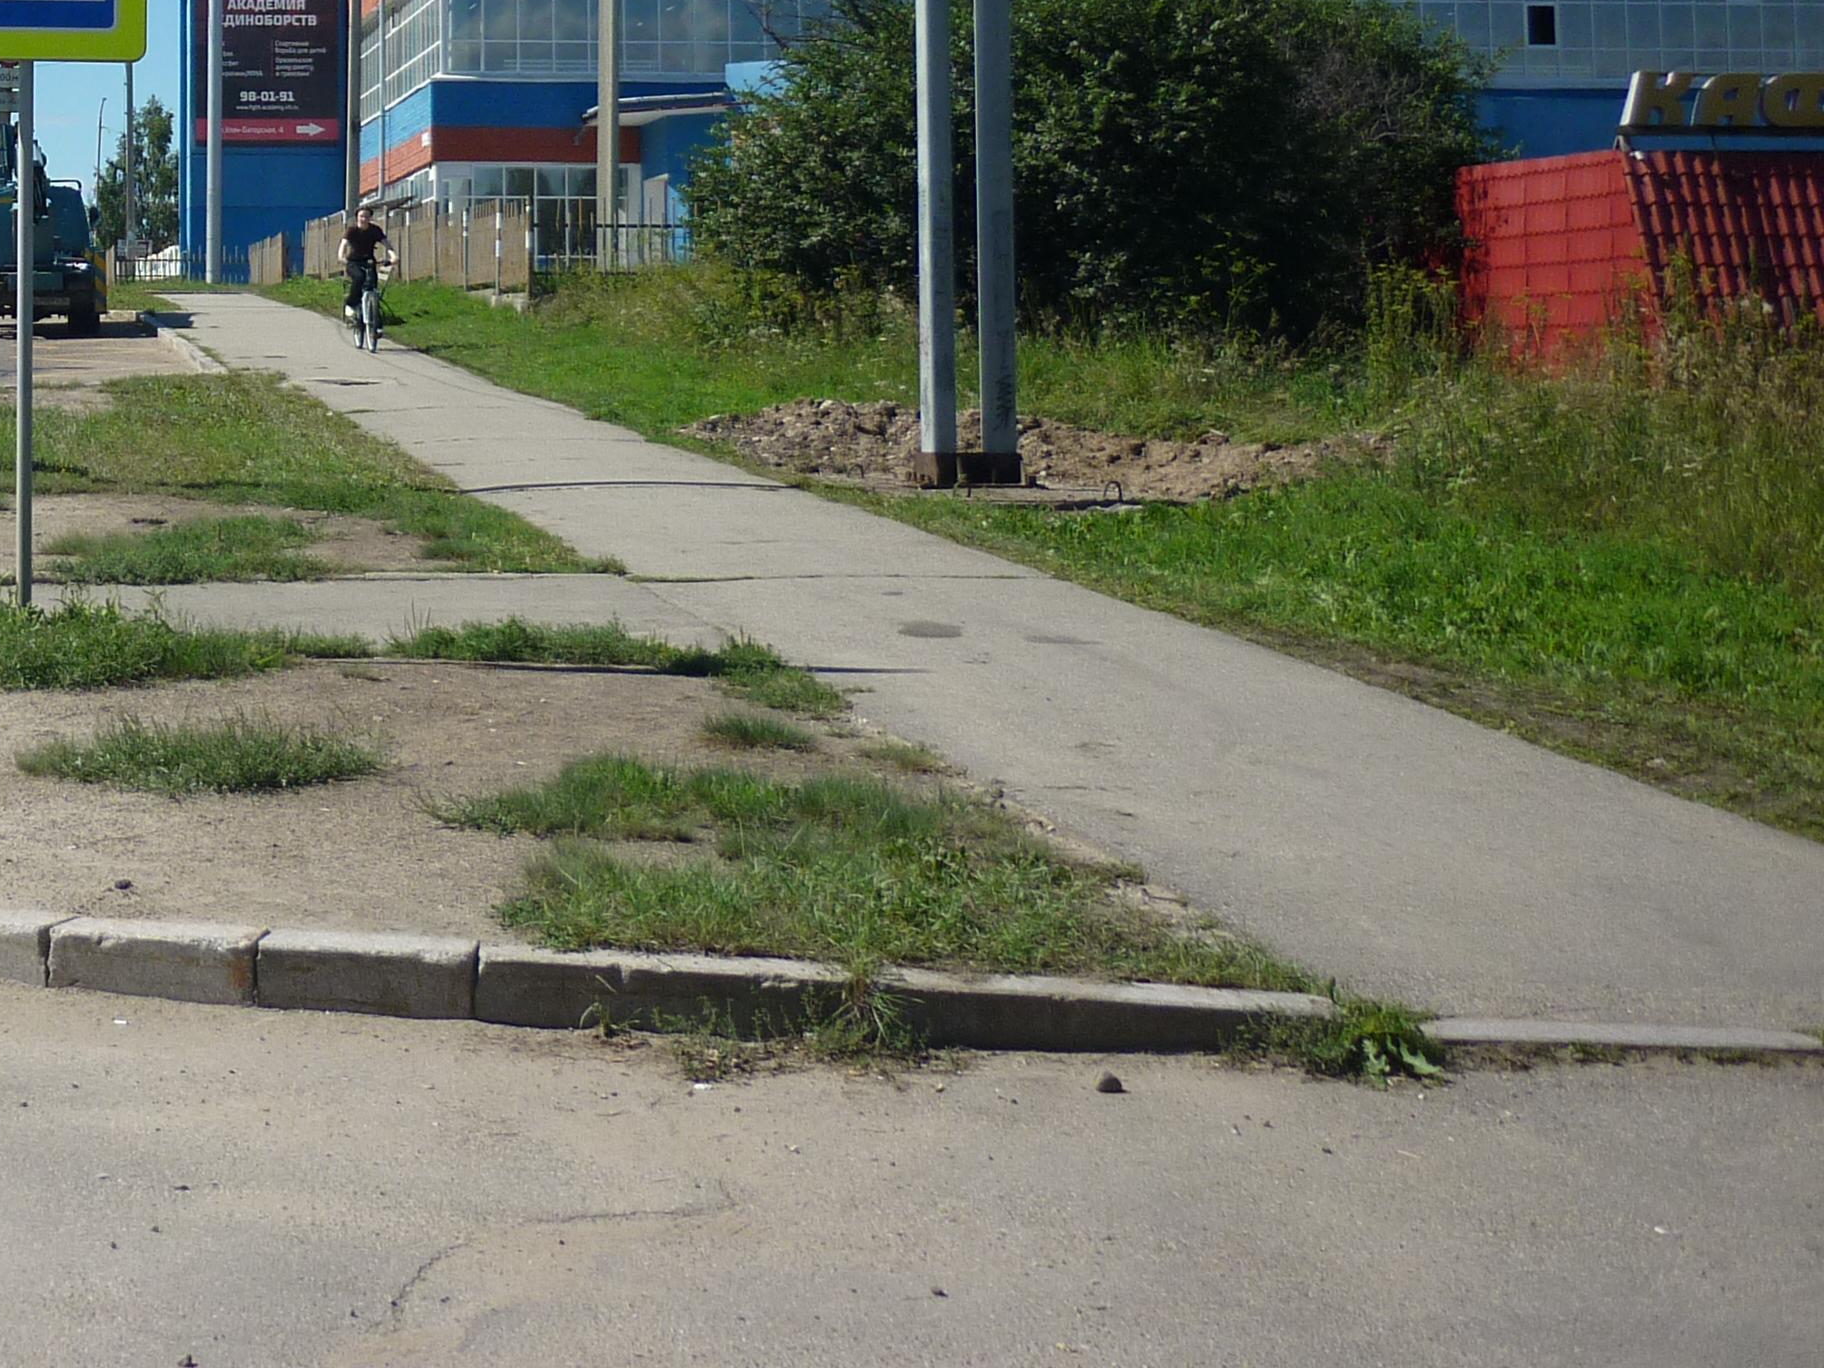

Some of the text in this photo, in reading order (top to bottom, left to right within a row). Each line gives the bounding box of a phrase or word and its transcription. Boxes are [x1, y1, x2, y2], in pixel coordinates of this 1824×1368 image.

[227, 0, 306, 11] АКАДЕМИЯ
[222, 15, 318, 27] ДИНОБОРСТВ
[239, 91, 296, 102] 98-01-91
